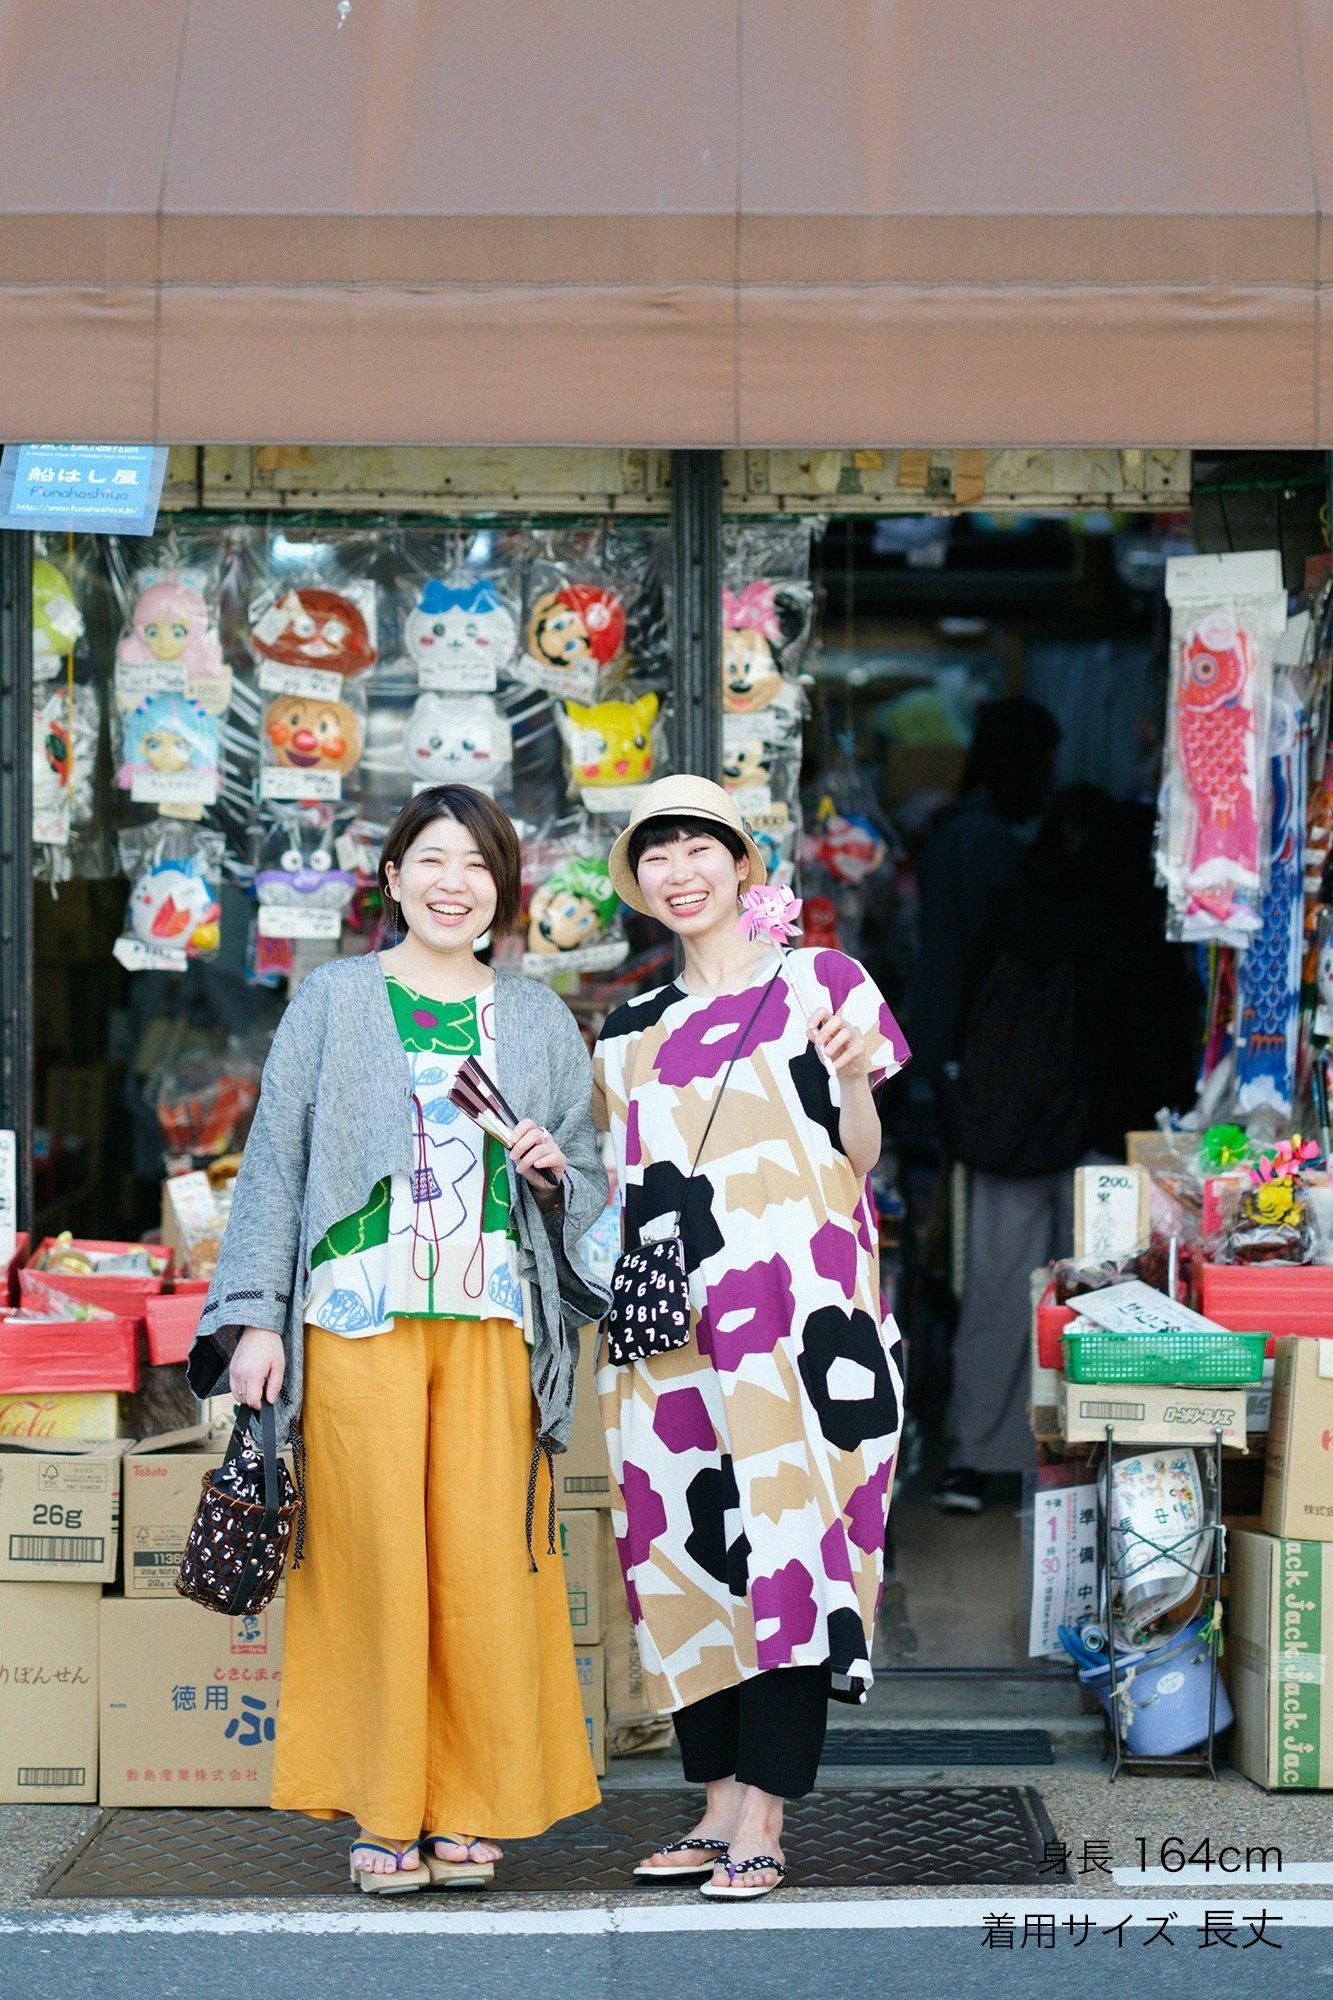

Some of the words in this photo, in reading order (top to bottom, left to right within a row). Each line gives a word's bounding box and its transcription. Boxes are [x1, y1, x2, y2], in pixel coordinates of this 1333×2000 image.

[28, 466, 140, 485] 船はし屋
[30, 485, 129, 501] Funahashiya
[33, 1504, 82, 1529] 26g
[172, 1684, 229, 1711] 徳用
[225, 1695, 280, 1746] ふ
[126, 1768, 259, 1782] 敷島産業株式会社
